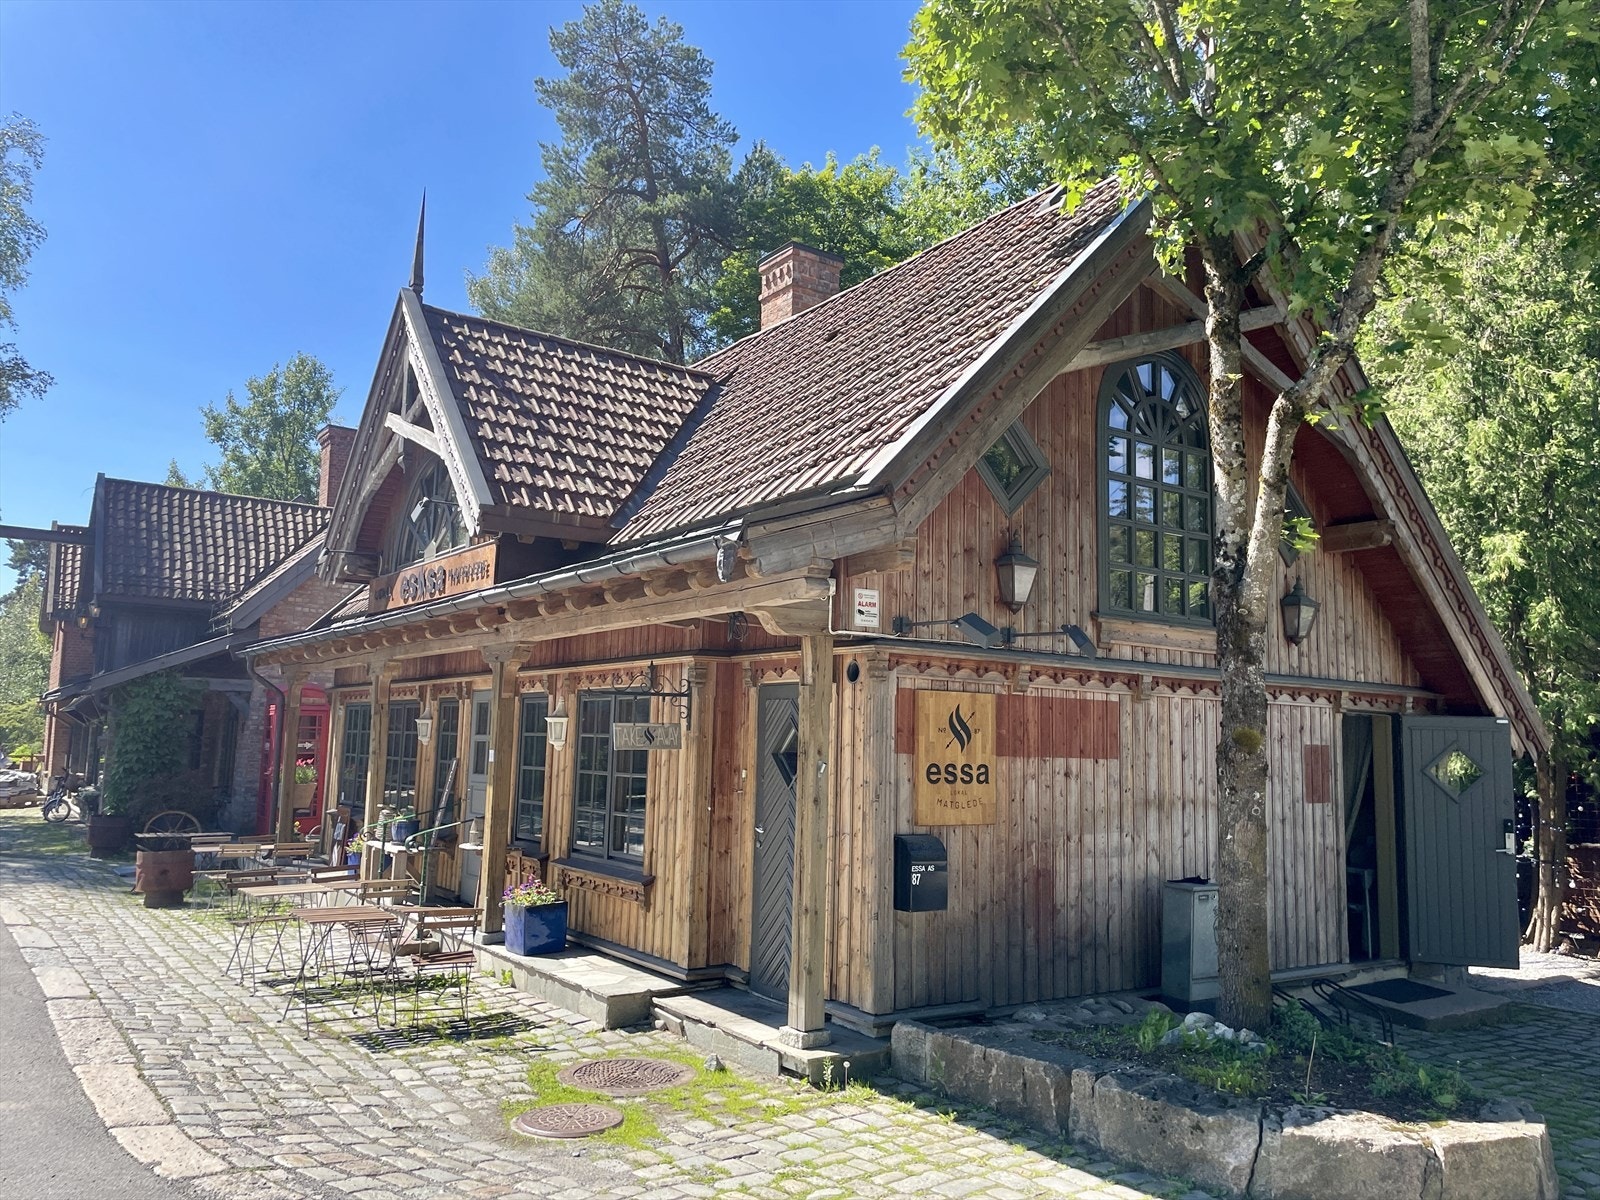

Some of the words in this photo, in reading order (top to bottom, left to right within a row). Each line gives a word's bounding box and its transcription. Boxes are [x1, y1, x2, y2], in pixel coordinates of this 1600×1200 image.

[615, 727, 643, 746] TAKE
[926, 763, 990, 785] essa
[936, 798, 984, 810] MATGLEDE
[911, 873, 921, 885] 87
